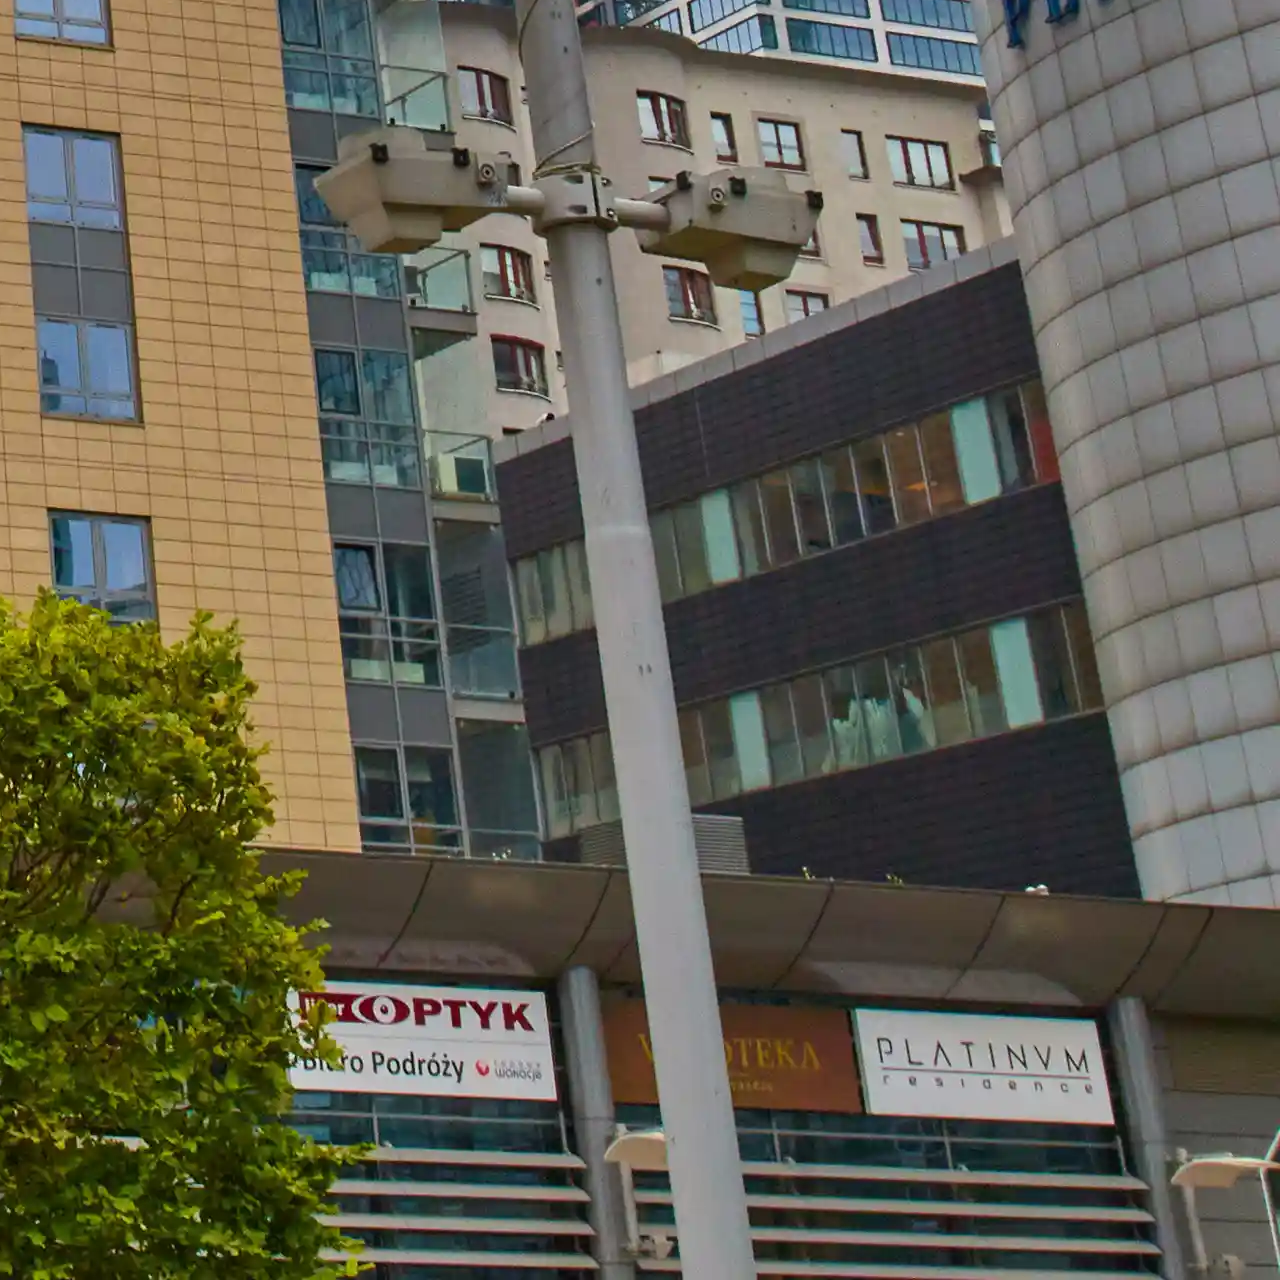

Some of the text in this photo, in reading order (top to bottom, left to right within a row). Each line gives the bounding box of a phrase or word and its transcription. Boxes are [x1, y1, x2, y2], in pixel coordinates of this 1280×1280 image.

[355, 994, 536, 1032] OPTYK
[371, 1050, 465, 1083] Podróży
[876, 1037, 1090, 1074] PLATINVM
[882, 1075, 1093, 1095] residence
